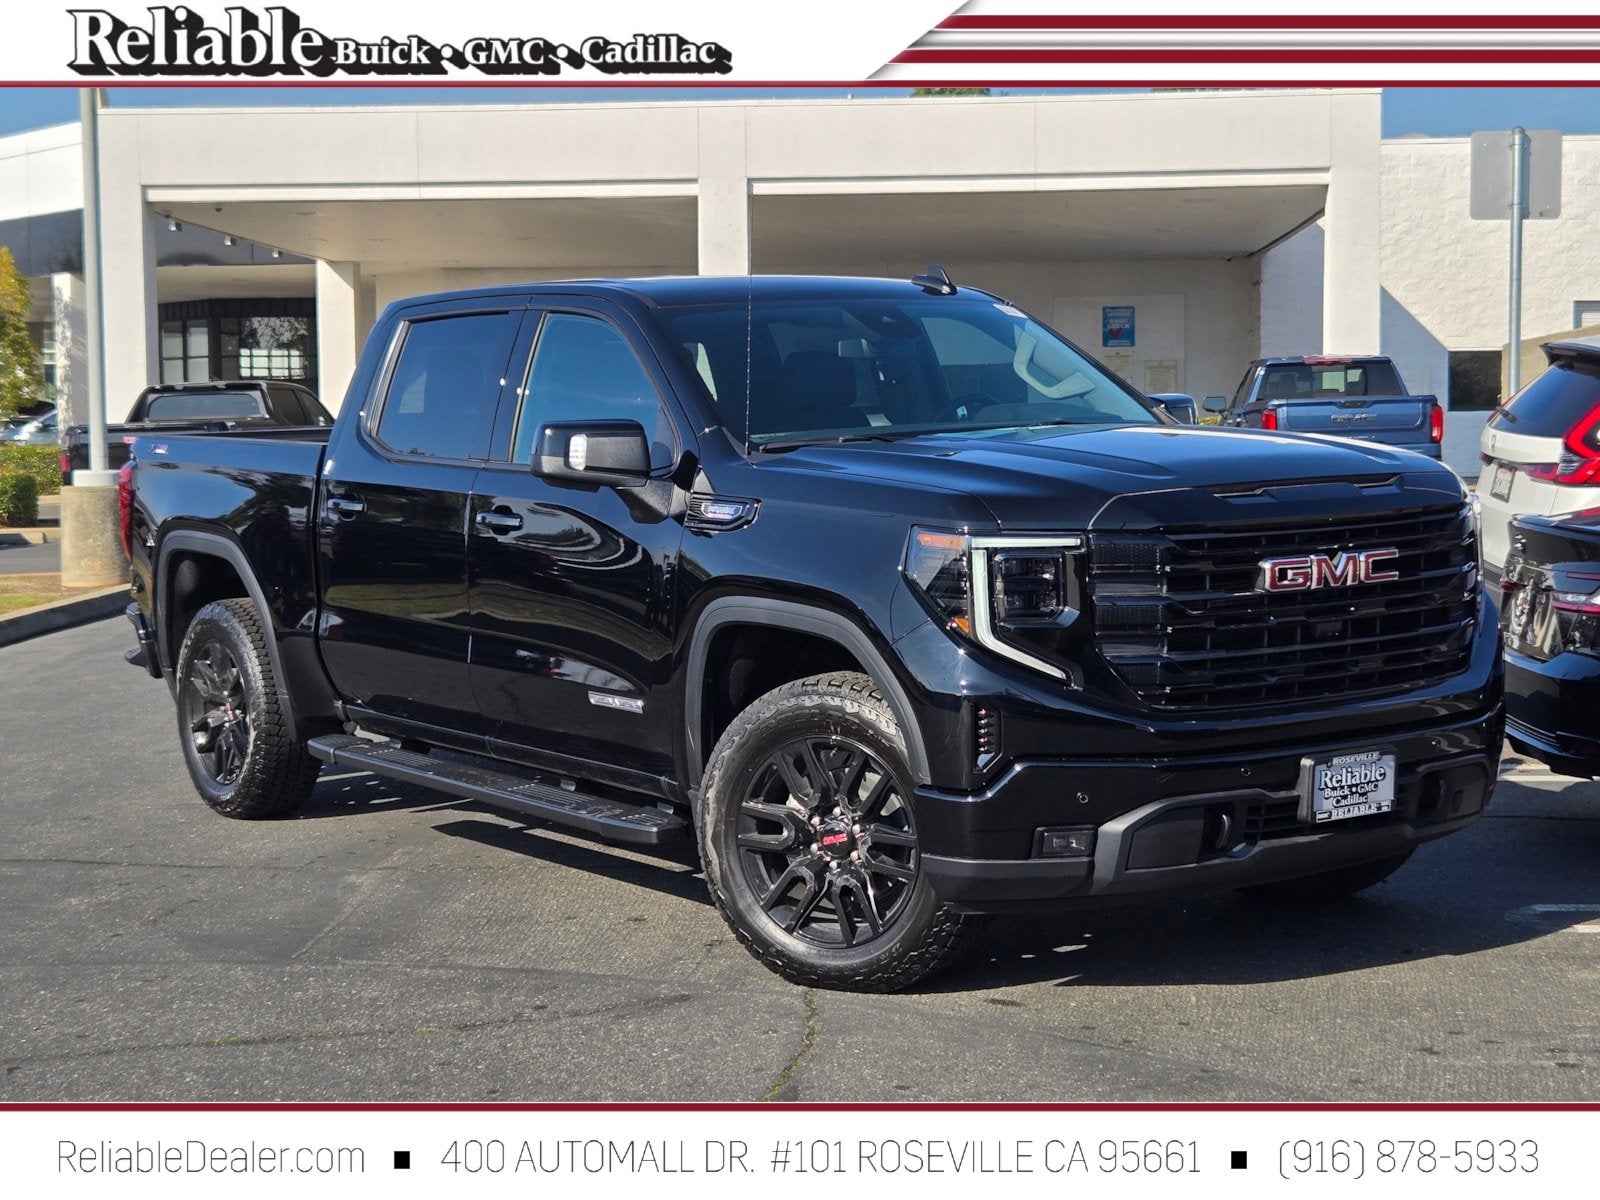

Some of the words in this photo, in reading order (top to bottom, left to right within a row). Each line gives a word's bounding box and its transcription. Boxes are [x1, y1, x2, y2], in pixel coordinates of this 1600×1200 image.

[1258, 549, 1399, 592] GMC
[1333, 751, 1380, 764] ROSEVILLE
[1319, 762, 1386, 790] Reliable
[1323, 785, 1350, 799] Buick
[1357, 781, 1379, 794] GMC
[1332, 793, 1369, 808] Cadillac
[1331, 803, 1378, 819] RELIABLE
[823, 833, 848, 846] GMC
